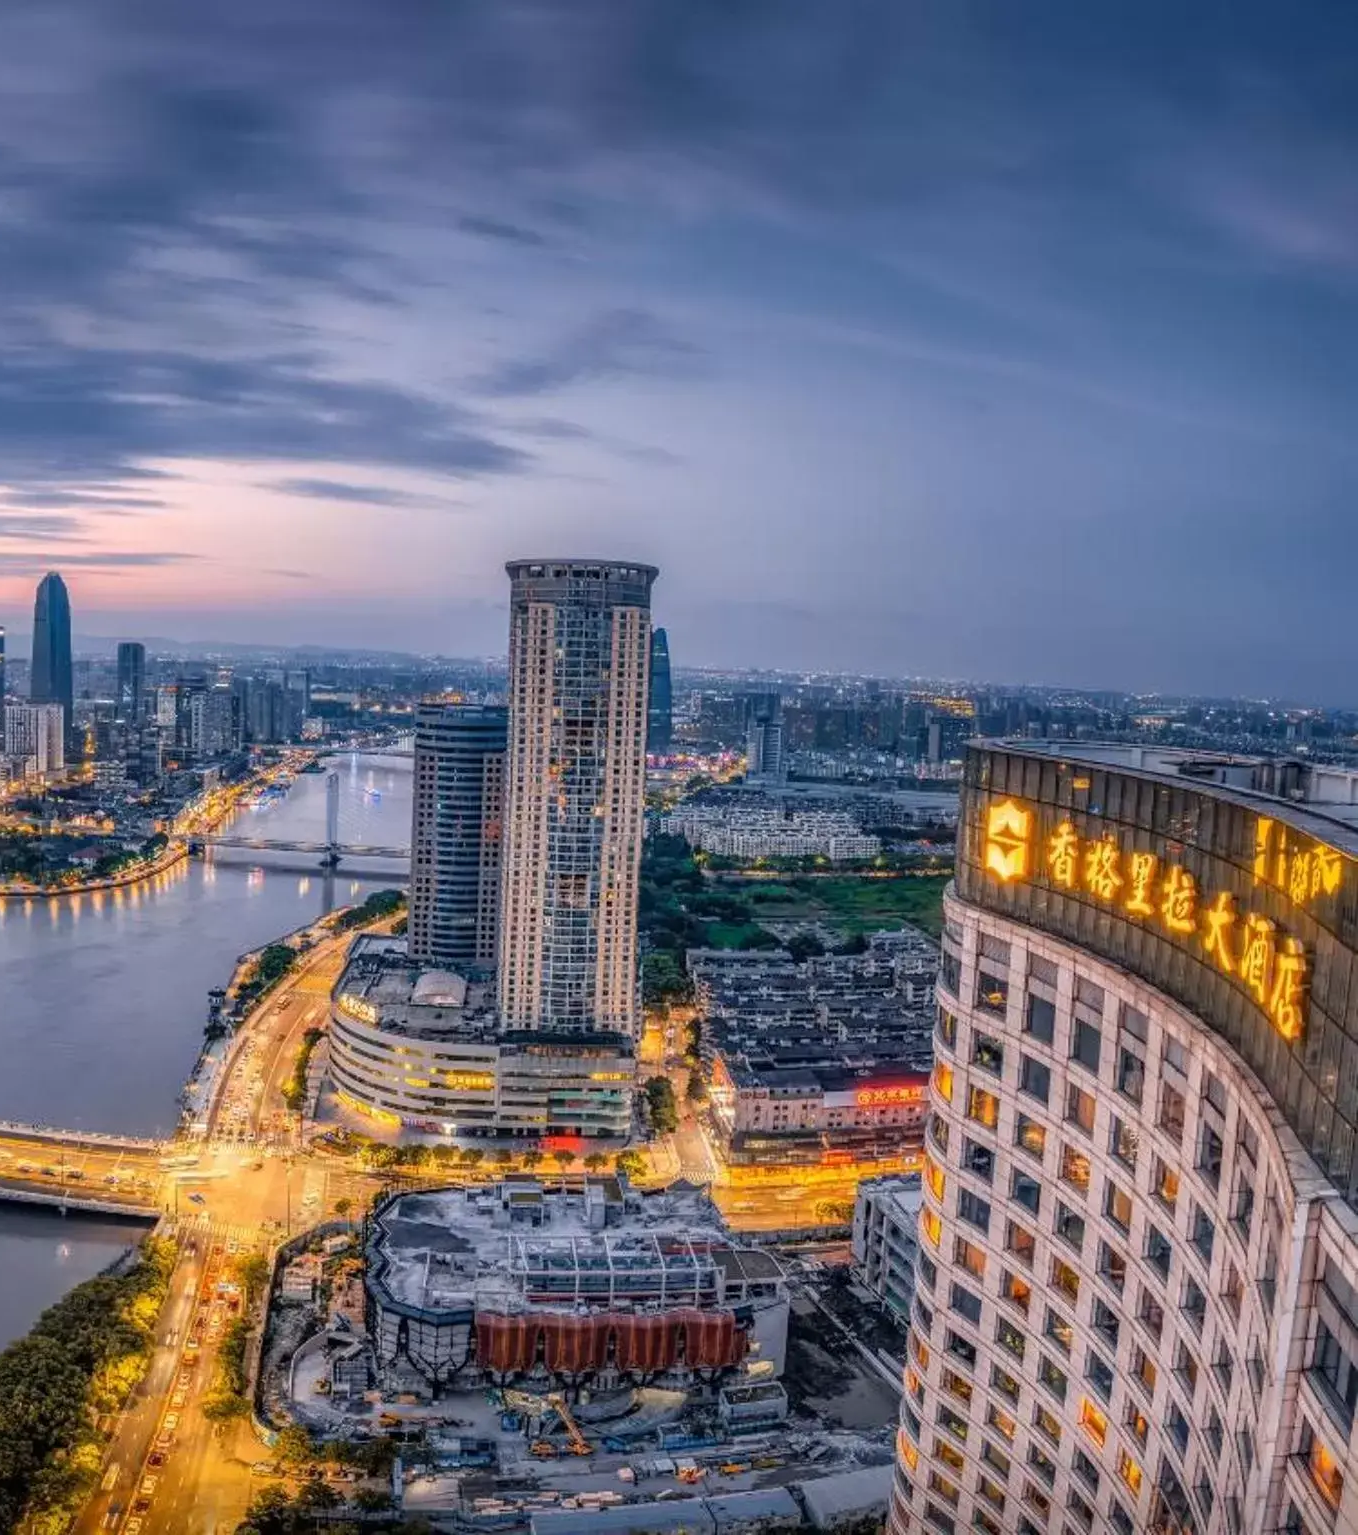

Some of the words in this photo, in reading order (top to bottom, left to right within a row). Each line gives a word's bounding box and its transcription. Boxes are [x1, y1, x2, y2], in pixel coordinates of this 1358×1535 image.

[1048, 817, 1306, 1040] 香格里拉大酒店
